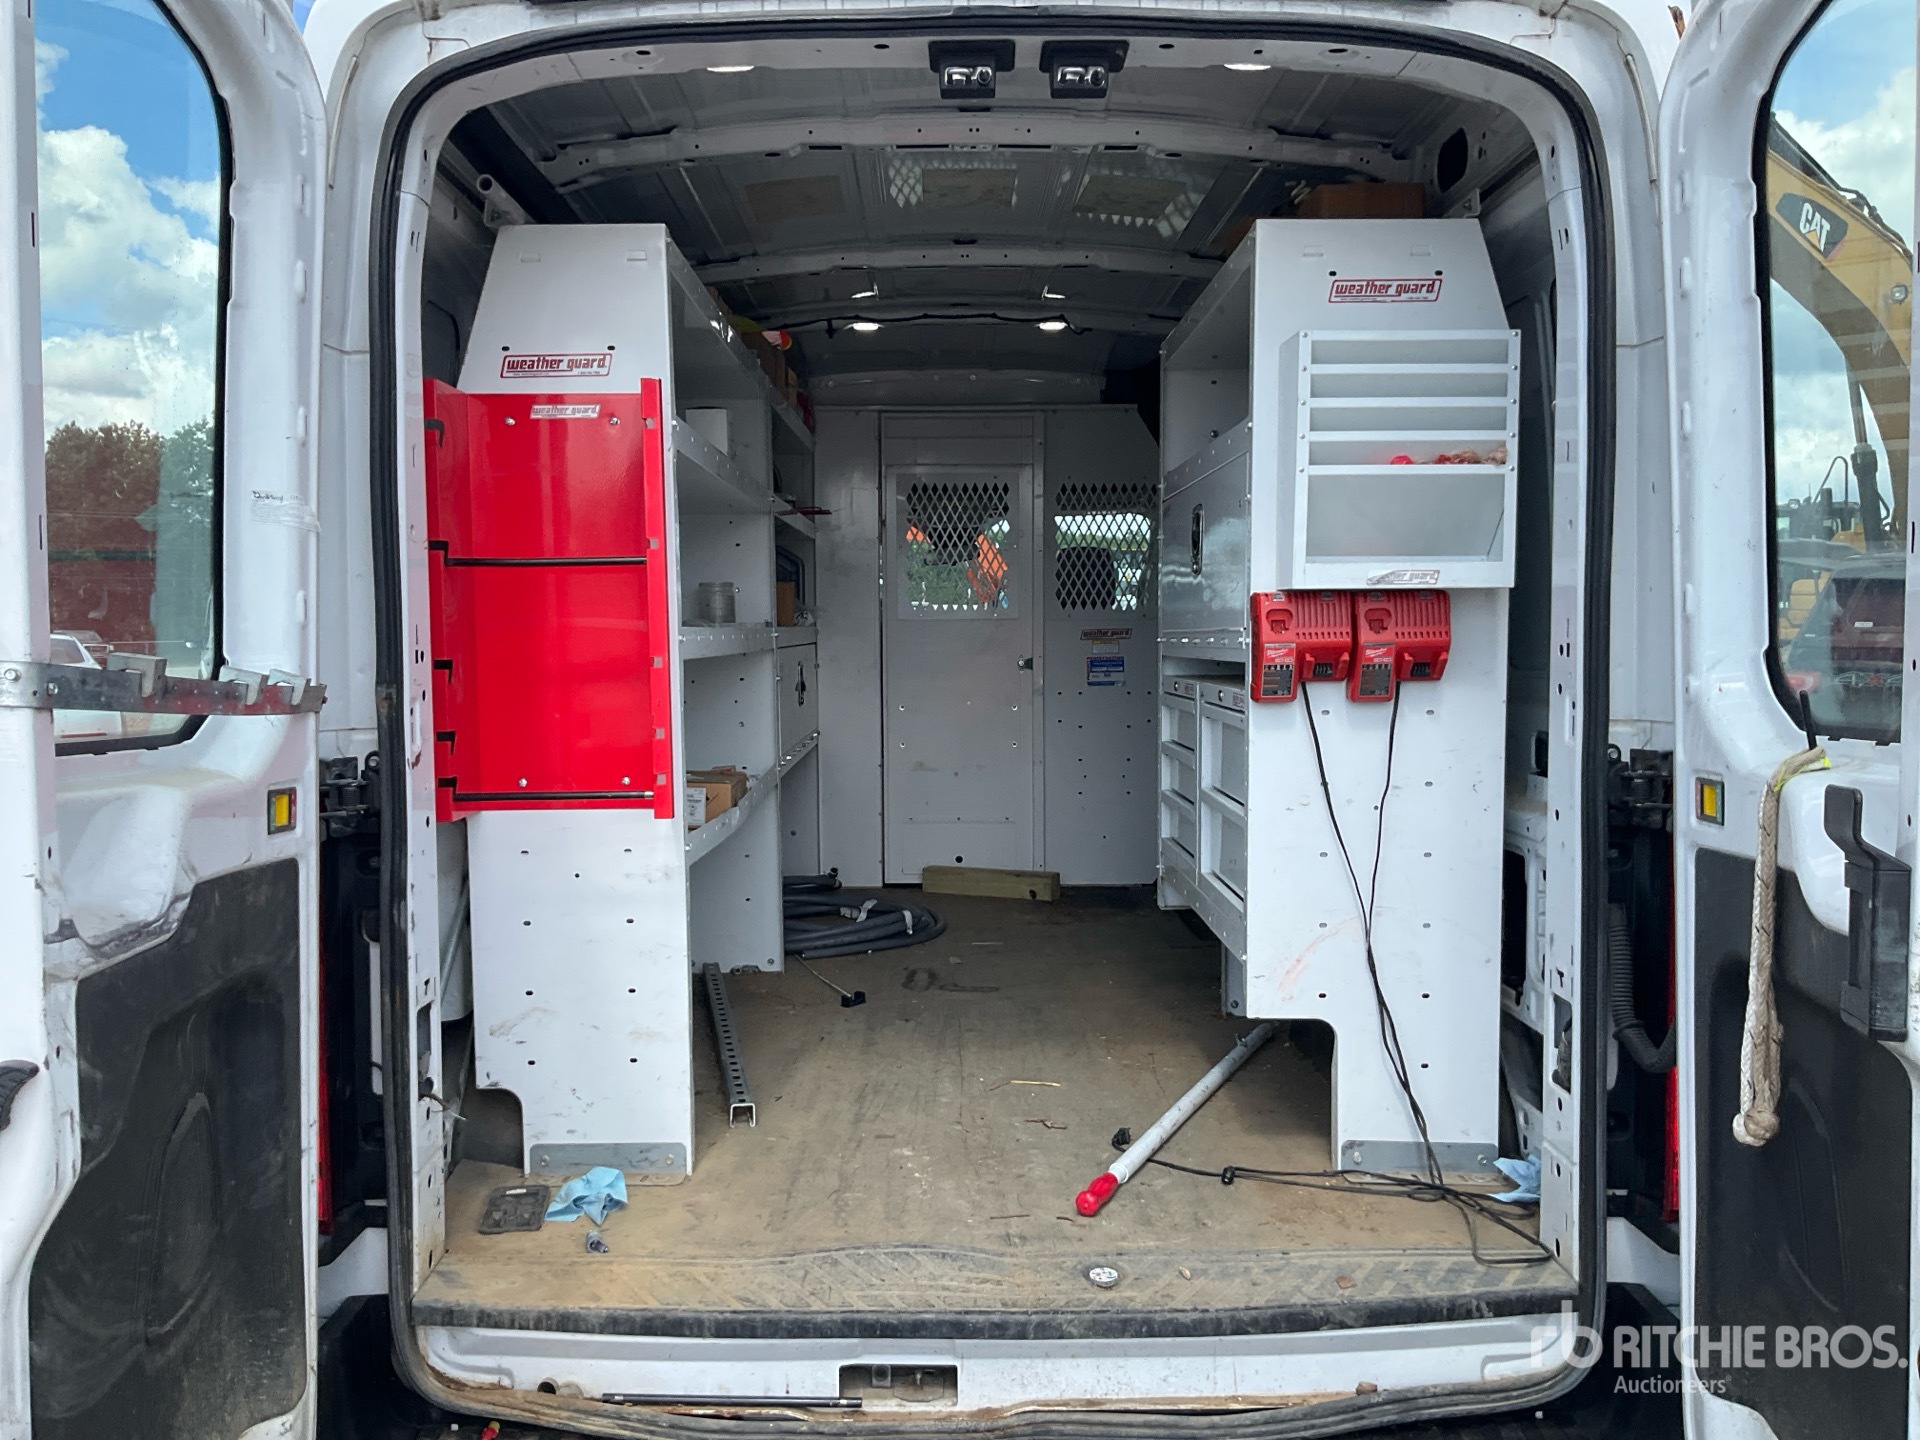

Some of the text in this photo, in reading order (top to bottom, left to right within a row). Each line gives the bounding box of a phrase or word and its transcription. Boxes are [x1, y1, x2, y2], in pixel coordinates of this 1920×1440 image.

[1800, 202, 1831, 252] CAT
[1335, 280, 1435, 297] weather guard
[506, 355, 606, 372] weather guard
[532, 405, 598, 415] weather guard
